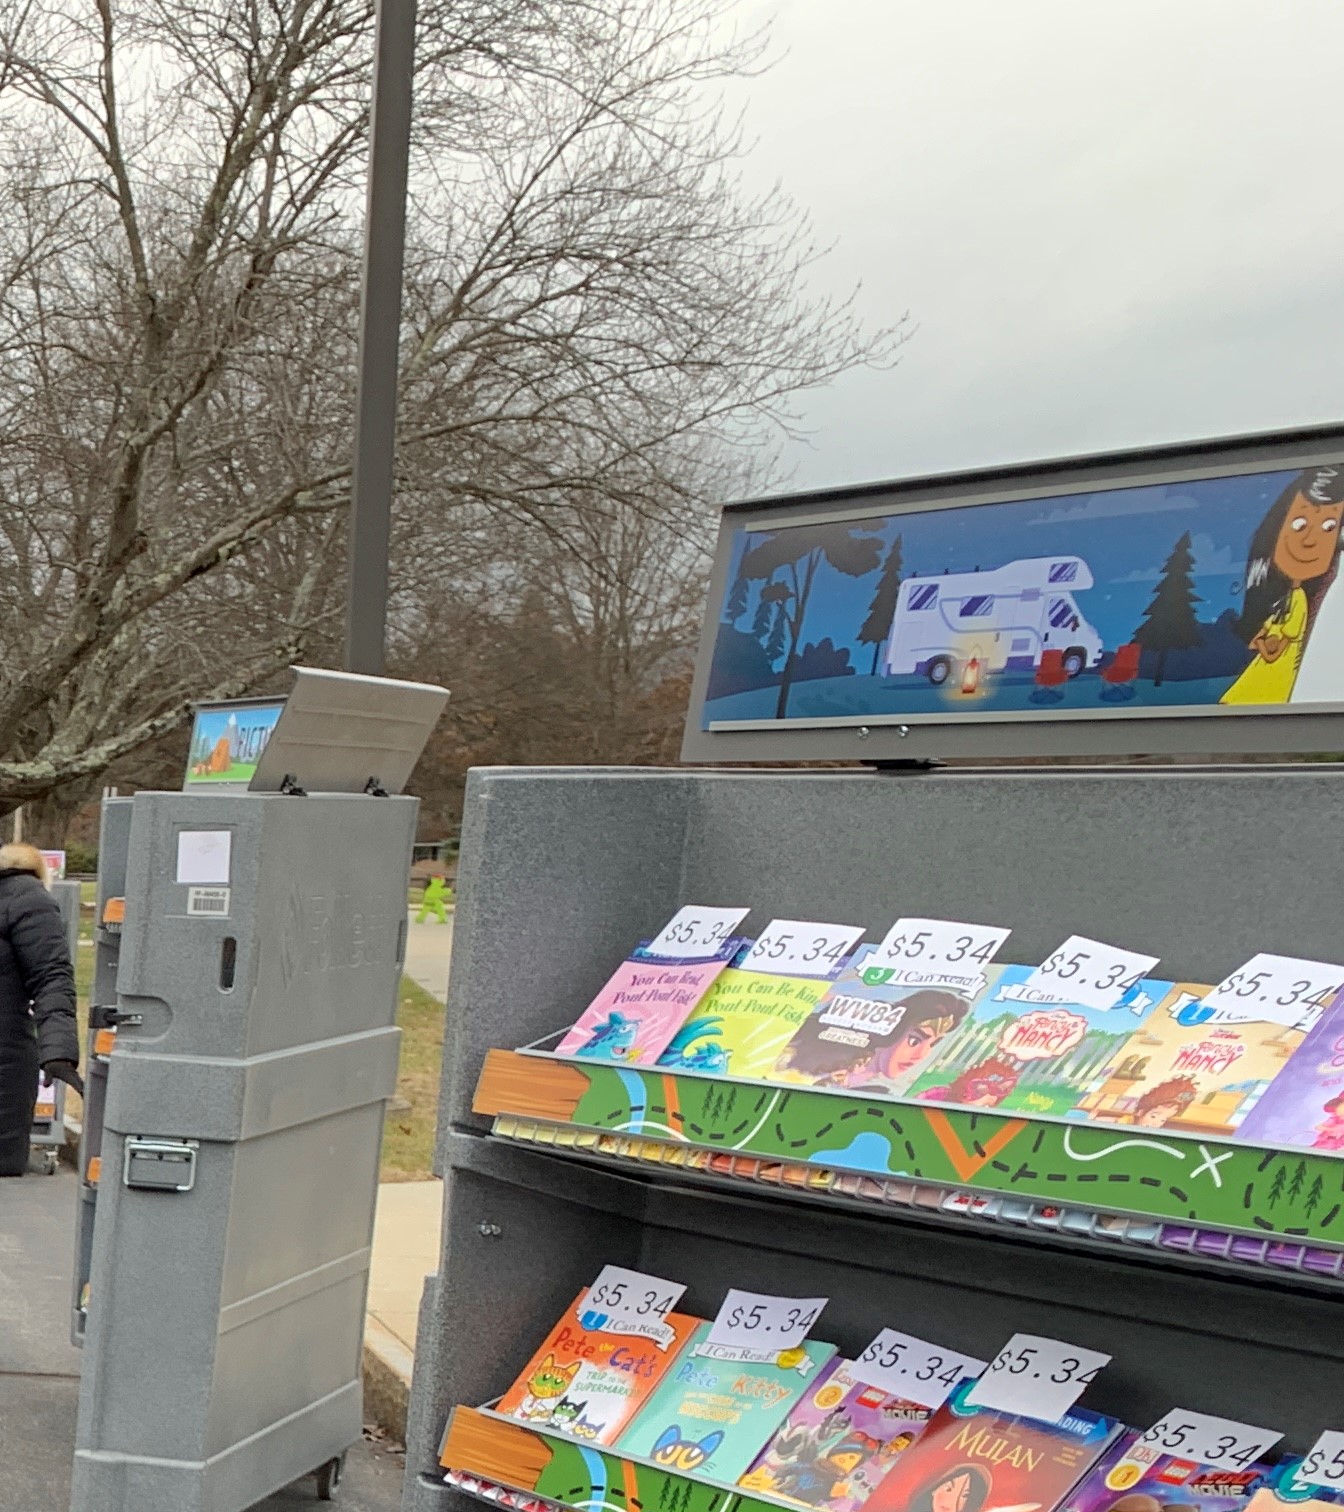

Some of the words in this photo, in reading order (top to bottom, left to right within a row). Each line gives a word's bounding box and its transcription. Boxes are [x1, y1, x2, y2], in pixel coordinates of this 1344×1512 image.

[665, 920, 733, 945] $5.34
[753, 934, 850, 964] $5.34
[887, 932, 998, 965] $5.34
[630, 974, 654, 987] You
[657, 972, 676, 985] Can
[713, 982, 742, 996] You
[747, 981, 774, 994] Can
[775, 983, 795, 996] Be
[905, 970, 933, 983] Can
[1042, 951, 1149, 998] $5.34
[1218, 972, 1335, 1011] $5.34
[830, 996, 903, 1026] WW84
[1007, 1023, 1078, 1053] NANCY
[1172, 1047, 1243, 1076] NANCY
[593, 1283, 674, 1318] $5.34
[613, 1319, 637, 1331] Can
[727, 1305, 819, 1333] $5.34
[552, 1326, 595, 1358] Pete
[714, 1346, 736, 1359] Can
[739, 1350, 775, 1362] Read!
[609, 1347, 657, 1378] Cat's
[676, 1361, 718, 1388] Pete
[863, 1341, 964, 1388] $5.34
[992, 1348, 1100, 1385] $5.34
[732, 1373, 793, 1409] Kitty
[944, 1422, 1046, 1473] MULAN
[1144, 1422, 1263, 1468] $5.34
